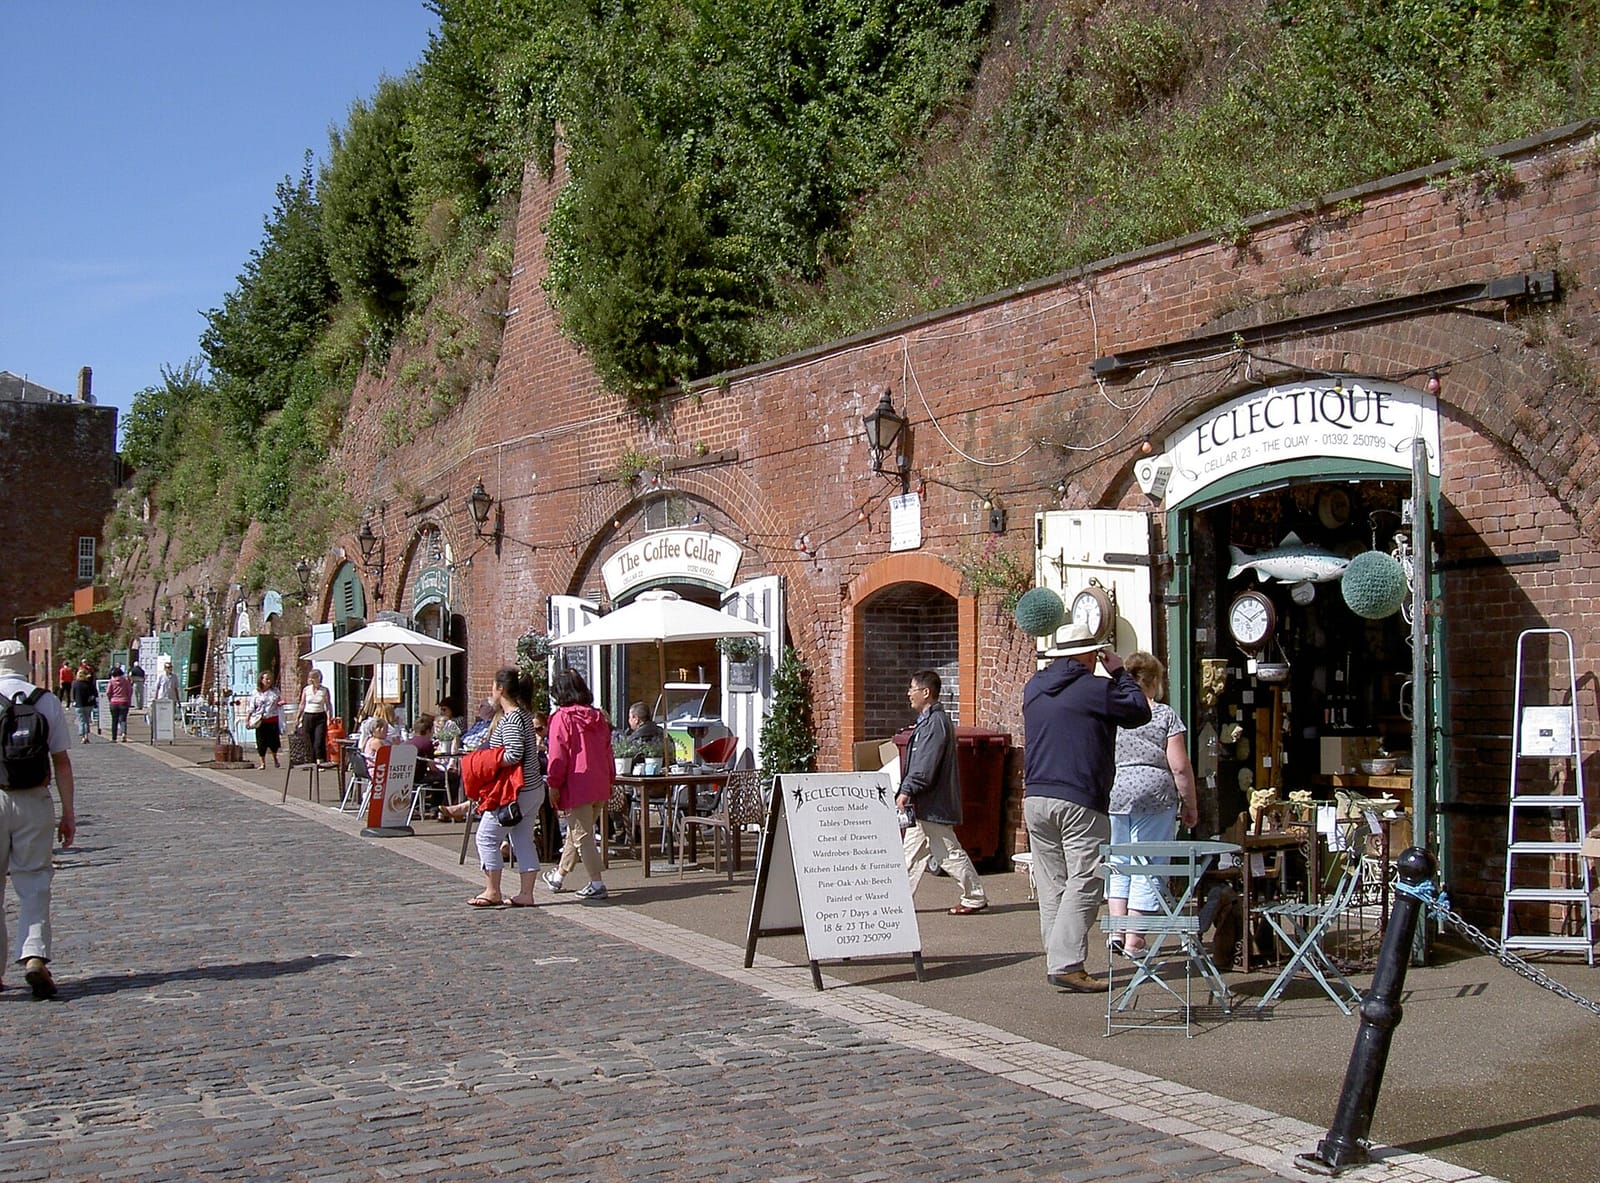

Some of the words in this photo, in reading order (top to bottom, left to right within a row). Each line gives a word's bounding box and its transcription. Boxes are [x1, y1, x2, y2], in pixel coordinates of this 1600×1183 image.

[1196, 389, 1395, 456] ECLECTIQUE
[1204, 451, 1237, 473] CELLAR
[1241, 446, 1251, 459] 23
[1262, 438, 1280, 452] THE
[1283, 434, 1310, 449] QUAY
[1322, 433, 1348, 445] 01392
[1352, 433, 1386, 449] 250799
[618, 552, 640, 575] The
[643, 537, 681, 562] Coffee
[684, 536, 722, 565] Cellar
[389, 764, 407, 772] TASTE
[373, 764, 386, 800] ROCCA
[804, 786, 878, 802] ECLECTIQUE
[816, 804, 845, 813] Custom
[847, 803, 869, 811] Made
[817, 834, 838, 843] Chest
[839, 834, 847, 842] of
[850, 833, 878, 841] Drawers
[803, 865, 831, 874] Kitchen
[833, 864, 858, 872] Islands
[869, 862, 902, 870] Furniture
[826, 894, 853, 903] Painted
[864, 892, 889, 900] Waxed
[815, 911, 839, 921] Open
[841, 909, 847, 918] 7
[850, 909, 870, 919] Days
[881, 906, 904, 915] Week
[823, 924, 833, 933] 18
[835, 923, 842, 932] &
[846, 922, 856, 931] 23
[859, 921, 875, 930] The
[877, 920, 901, 930] Quay
[836, 935, 860, 945] 01392
[863, 932, 892, 943] 250799
